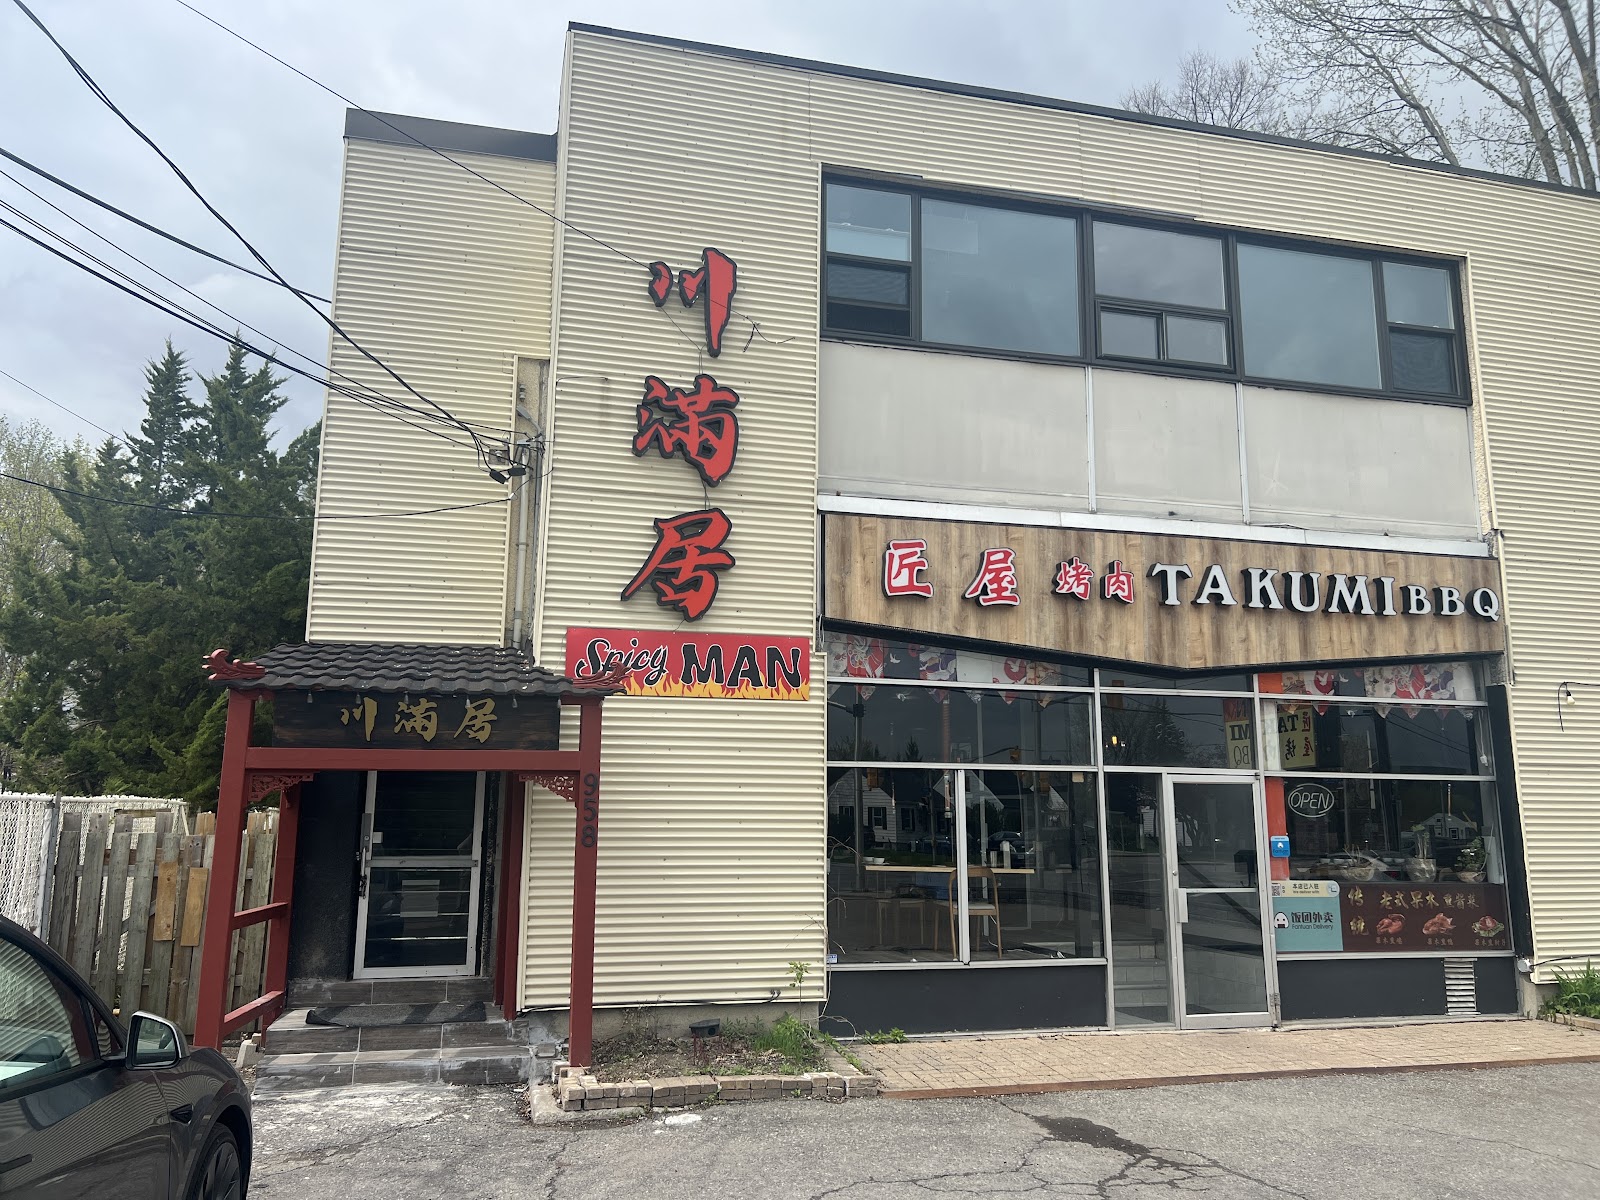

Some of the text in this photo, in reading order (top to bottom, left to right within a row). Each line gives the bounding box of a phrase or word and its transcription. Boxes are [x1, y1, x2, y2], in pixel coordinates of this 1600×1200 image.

[882, 538, 1134, 607] 匠屋 烤肉
[1147, 562, 1500, 622] TAKUMI BBQ
[575, 638, 802, 689] Spicy MAN
[581, 773, 599, 847] 958
[1291, 792, 1330, 809] OPEN
[1291, 911, 1334, 924] 饭团外卖
